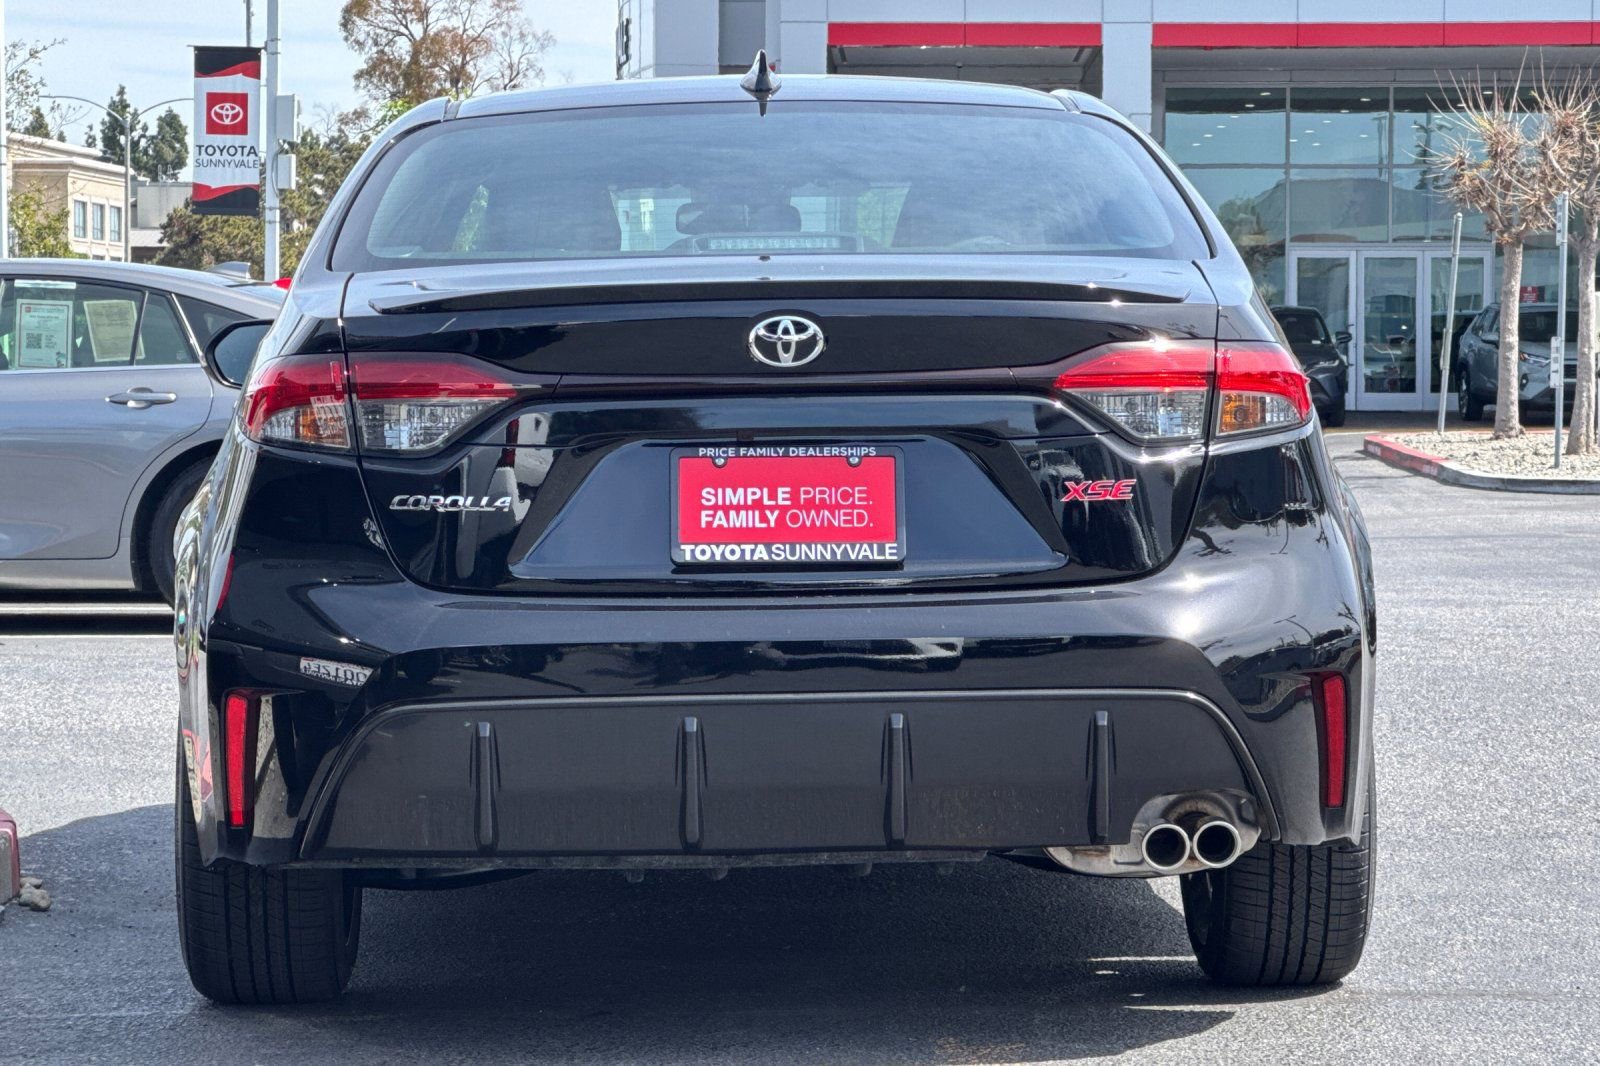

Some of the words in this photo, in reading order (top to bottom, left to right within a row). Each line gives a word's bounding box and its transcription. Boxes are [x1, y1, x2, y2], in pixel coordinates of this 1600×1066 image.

[195, 144, 258, 157] TOYOTA
[195, 158, 259, 169] SUNNYVALE
[699, 448, 736, 457] PRICE
[739, 447, 785, 457] FAMILY
[789, 447, 876, 457] DEALERSHIPS
[701, 487, 791, 506] SIMPLE
[799, 486, 873, 505] PRICE.
[1060, 479, 1137, 501] XSE
[389, 494, 512, 512] COROLLA
[701, 509, 779, 528] FAMILY
[786, 509, 874, 527] OWNED.
[680, 544, 769, 561] TOYOTA
[771, 543, 898, 560] SUNNYVALE
